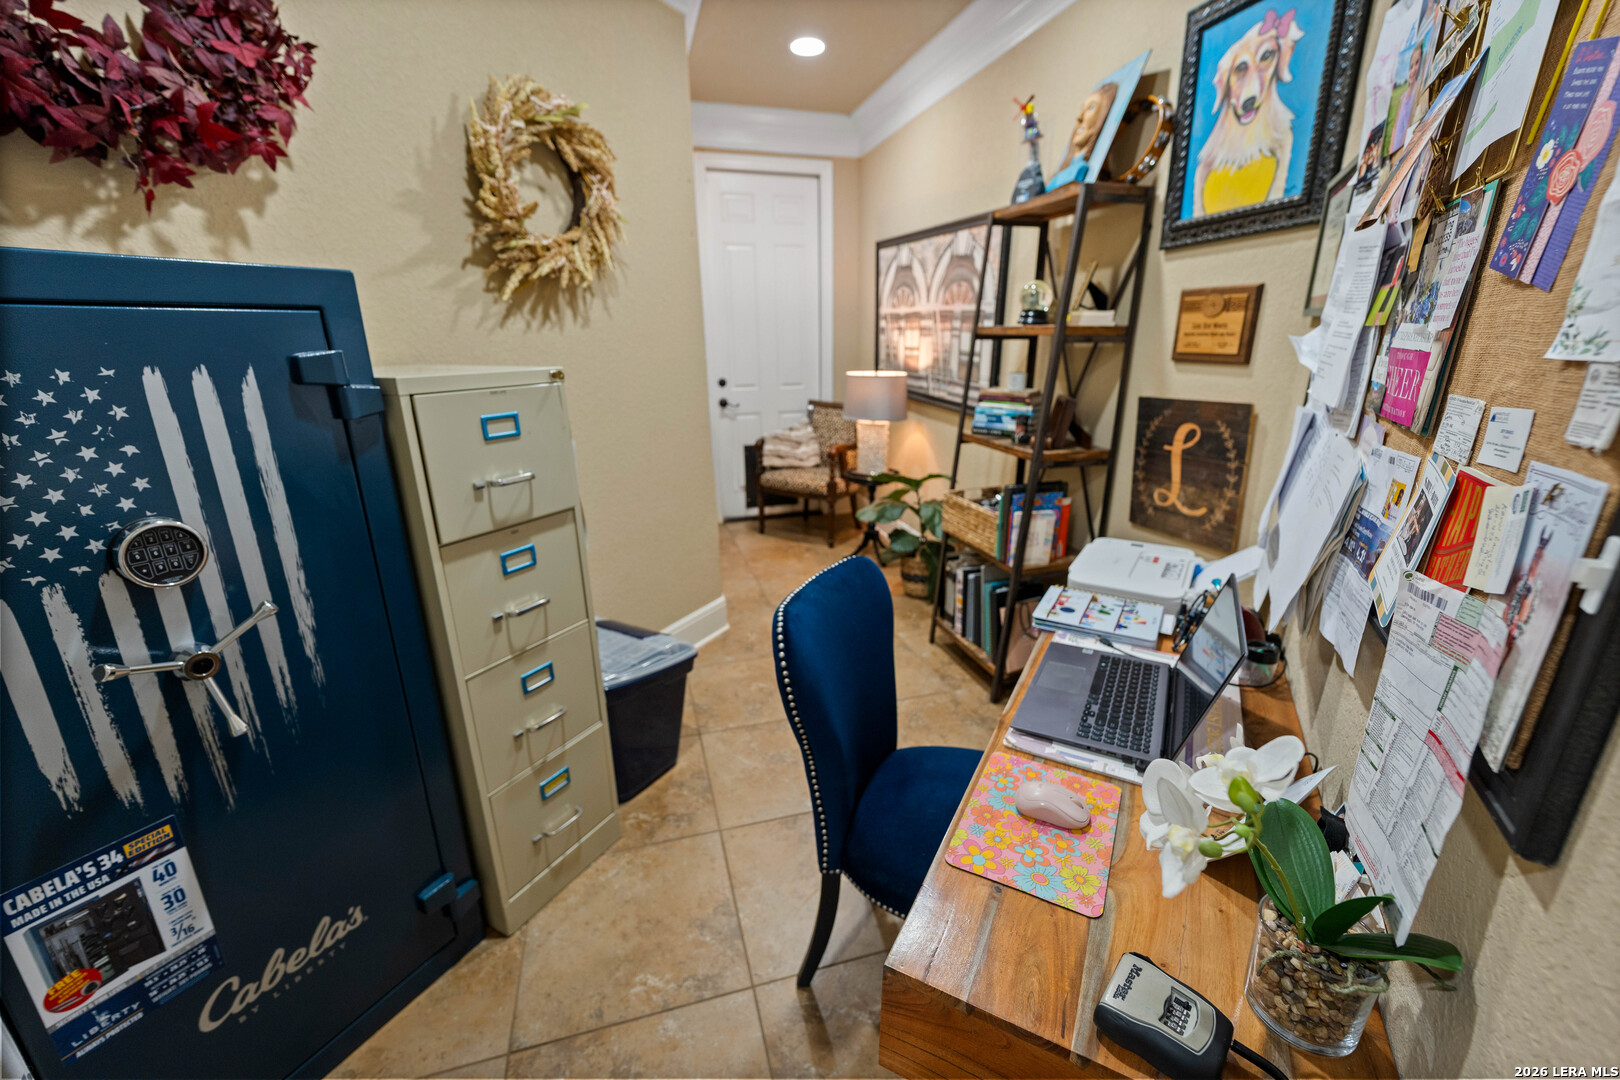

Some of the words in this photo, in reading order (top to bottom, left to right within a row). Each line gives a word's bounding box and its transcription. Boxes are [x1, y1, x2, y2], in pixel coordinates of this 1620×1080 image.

[127, 832, 171, 857] EDITION
[128, 827, 168, 850] SPECIAL
[2, 864, 97, 917] CABELA'S
[97, 850, 124, 871] 34
[152, 861, 177, 883] 40
[10, 906, 48, 929] MADE
[50, 896, 64, 908] IN
[65, 886, 86, 901] THE
[87, 875, 110, 892] USA
[160, 887, 186, 911] 30
[47, 968, 82, 996] FREE
[198, 905, 364, 1033] Cabela's
[1122, 963, 1143, 1002] Master
[71, 1001, 141, 1047] LIBERTY
